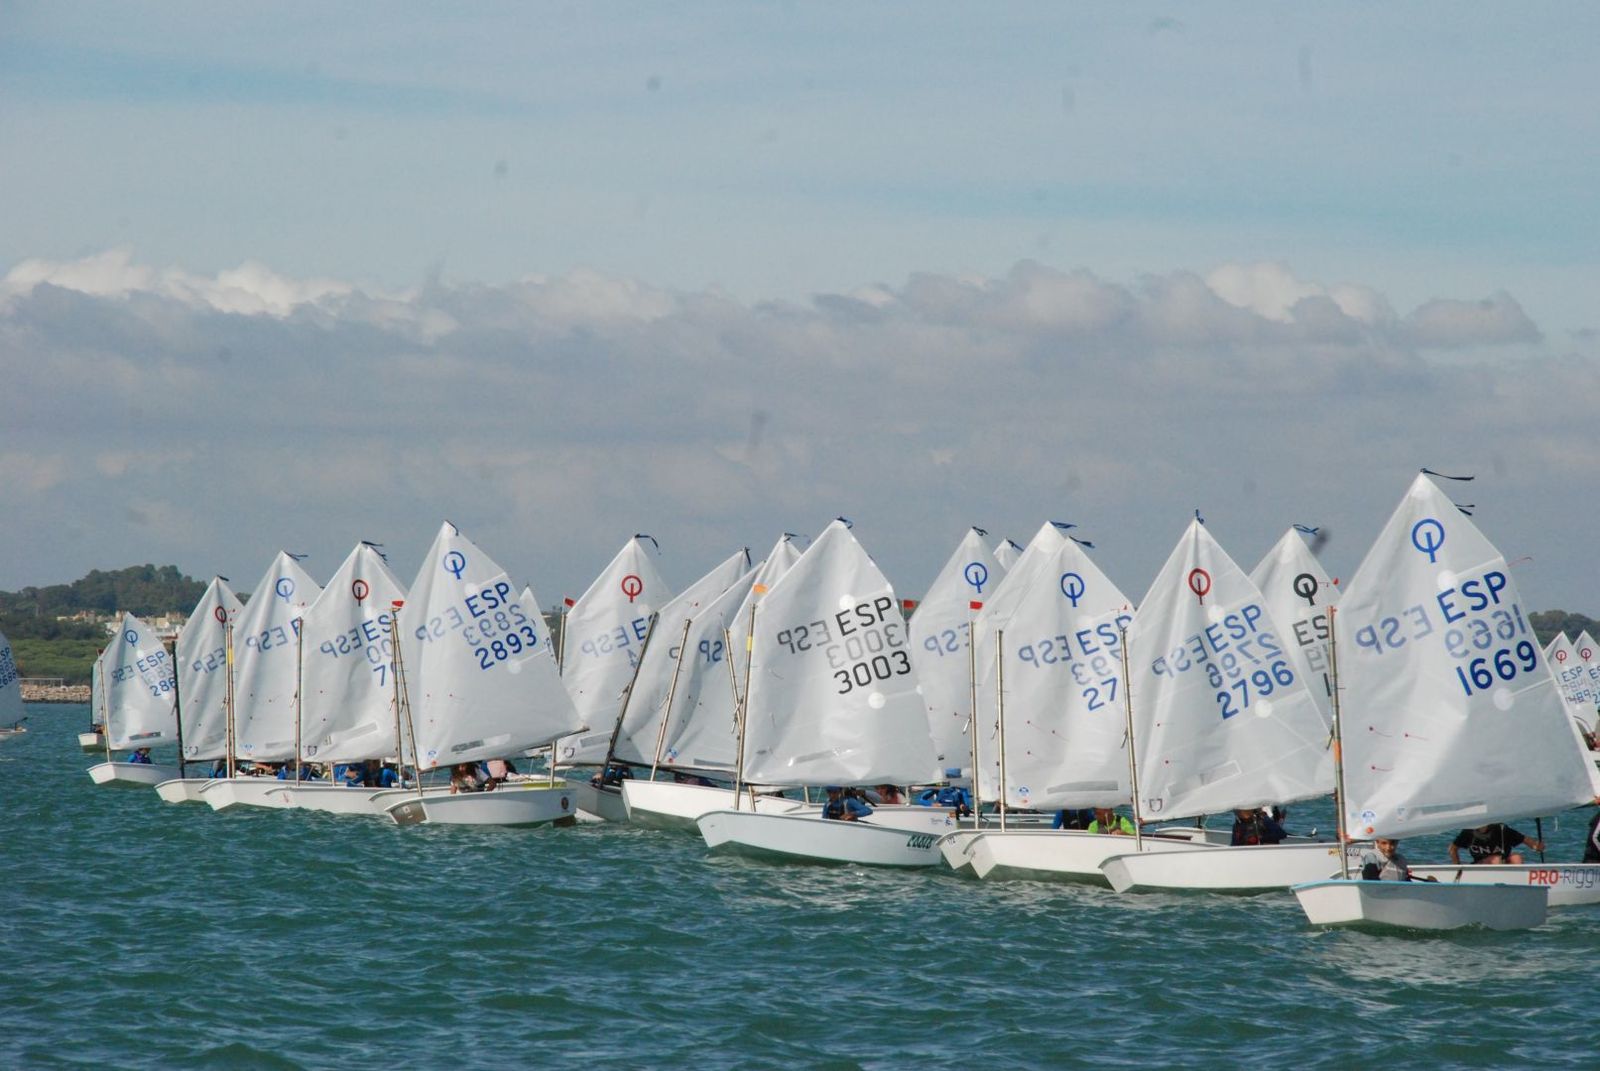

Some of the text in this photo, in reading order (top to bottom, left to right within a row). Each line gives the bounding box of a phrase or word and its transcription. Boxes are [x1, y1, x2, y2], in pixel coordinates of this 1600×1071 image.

[464, 582, 510, 618] ESP
[835, 596, 892, 637] ESP
[1436, 570, 1507, 624] ESP
[475, 625, 538, 670] 2893
[1205, 604, 1262, 653] ESP
[136, 650, 166, 673] ESP
[834, 650, 912, 695] 3003
[1455, 640, 1537, 697] 1669
[1561, 666, 1583, 682] ESP
[1216, 660, 1294, 720] 2796
